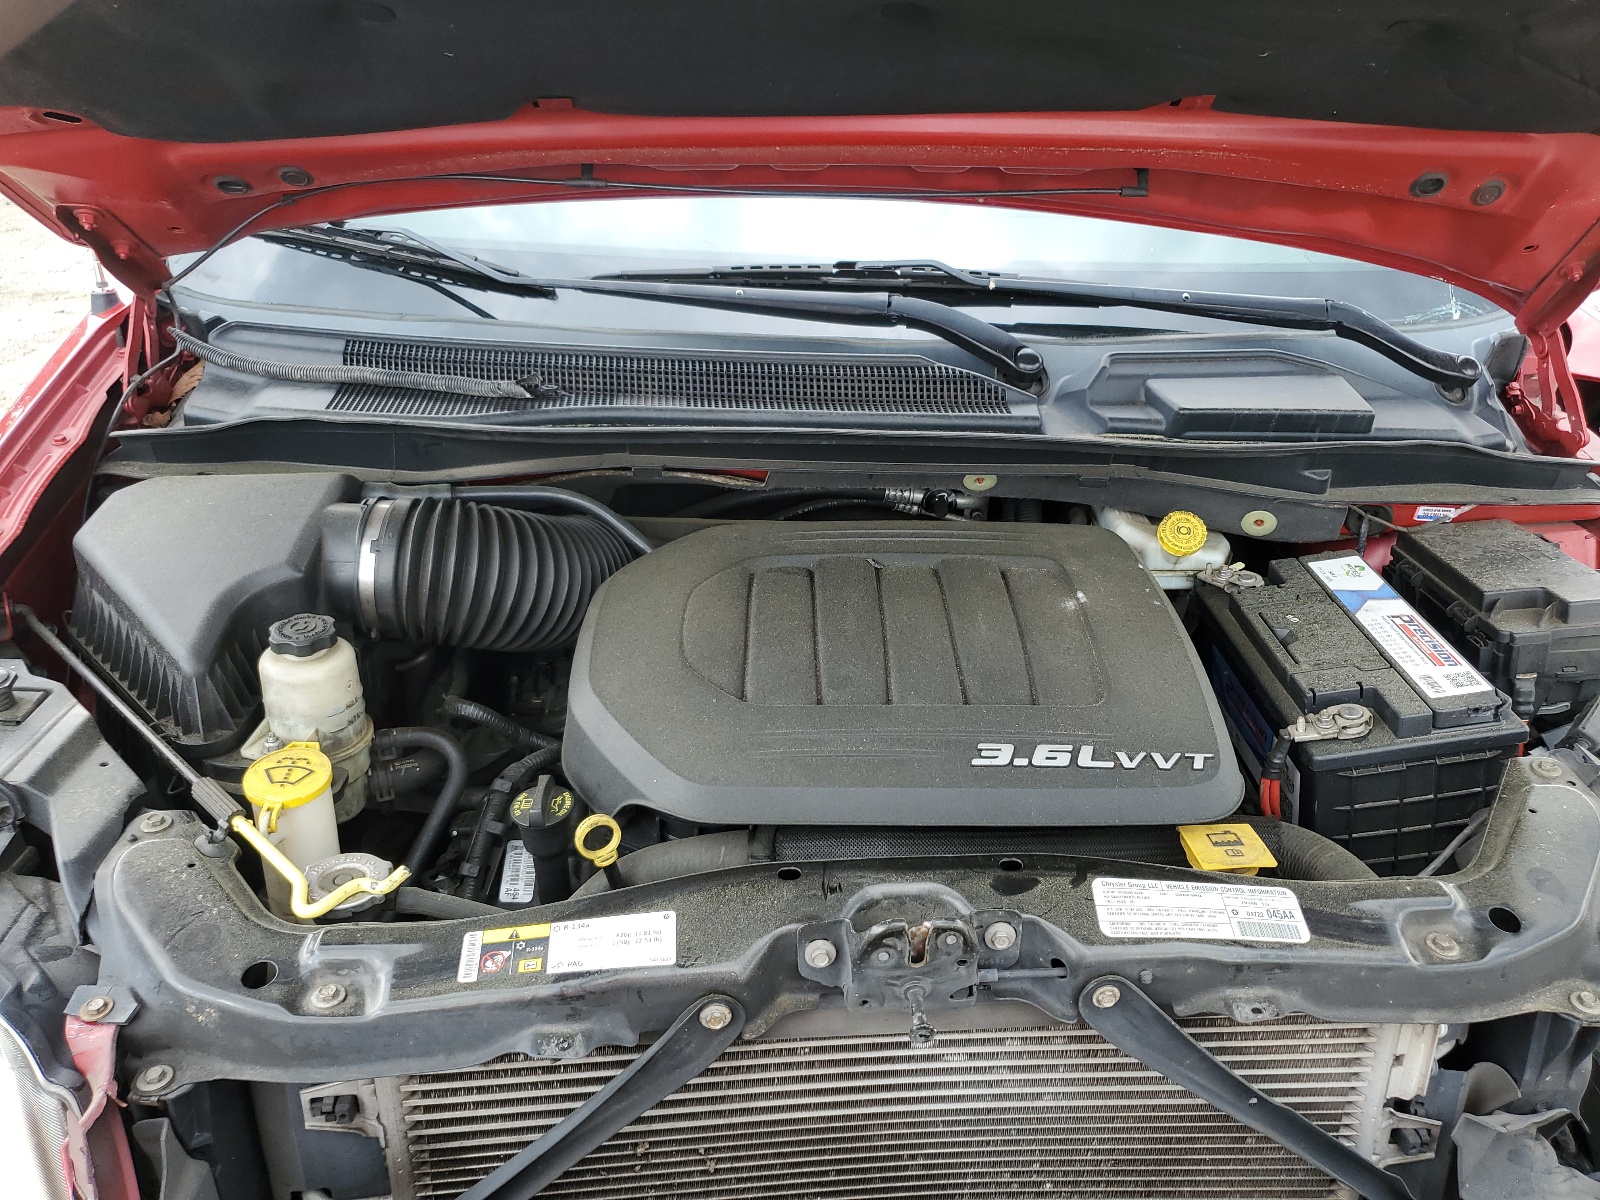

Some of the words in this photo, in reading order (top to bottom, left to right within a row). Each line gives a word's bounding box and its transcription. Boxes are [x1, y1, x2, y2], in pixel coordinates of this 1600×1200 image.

[1390, 613, 1458, 666] Precision
[971, 743, 1115, 768] 3.6L
[1115, 751, 1215, 769] VVT
[1101, 880, 1126, 889] Chrysler
[1127, 881, 1146, 890] Group
[1147, 881, 1159, 889] LLC
[1165, 883, 1189, 891] VEHICLE
[1191, 884, 1219, 892] EMISSION
[1220, 885, 1246, 893] CONTROL
[1248, 887, 1287, 896] INFORMATION
[567, 960, 584, 968] PAG
